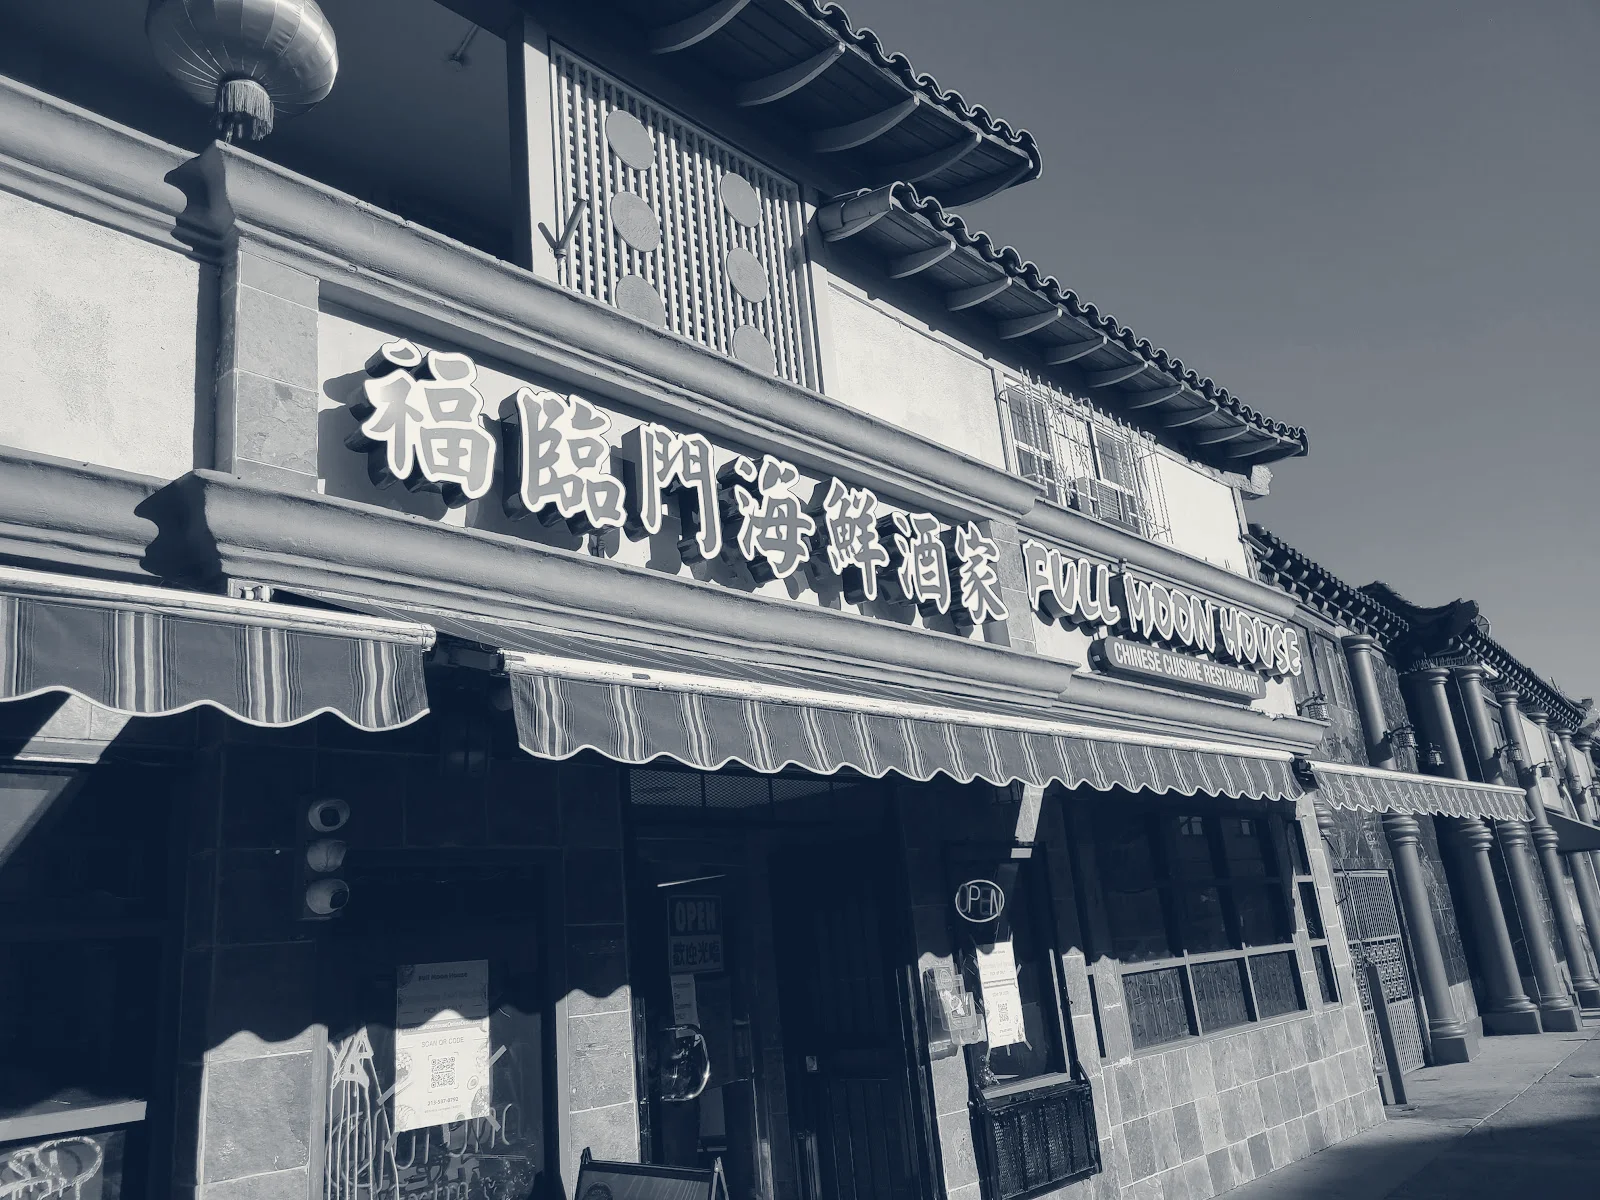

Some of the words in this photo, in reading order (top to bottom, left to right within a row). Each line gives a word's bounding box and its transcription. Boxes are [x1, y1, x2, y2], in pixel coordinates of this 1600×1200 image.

[361, 338, 1009, 625] 福臨門海鮮酒家
[1022, 538, 1121, 626] FULL
[1123, 571, 1216, 654] MOON
[1219, 606, 1302, 677] HOUSE
[1113, 641, 1163, 674] CHINESE
[1162, 653, 1204, 682] CUISINE
[1203, 663, 1261, 695] RESTAURANT
[674, 901, 717, 932] OPEN
[958, 883, 1002, 917] OPEN
[421, 1041, 437, 1049] SCAN
[448, 1036, 465, 1045] CODE
